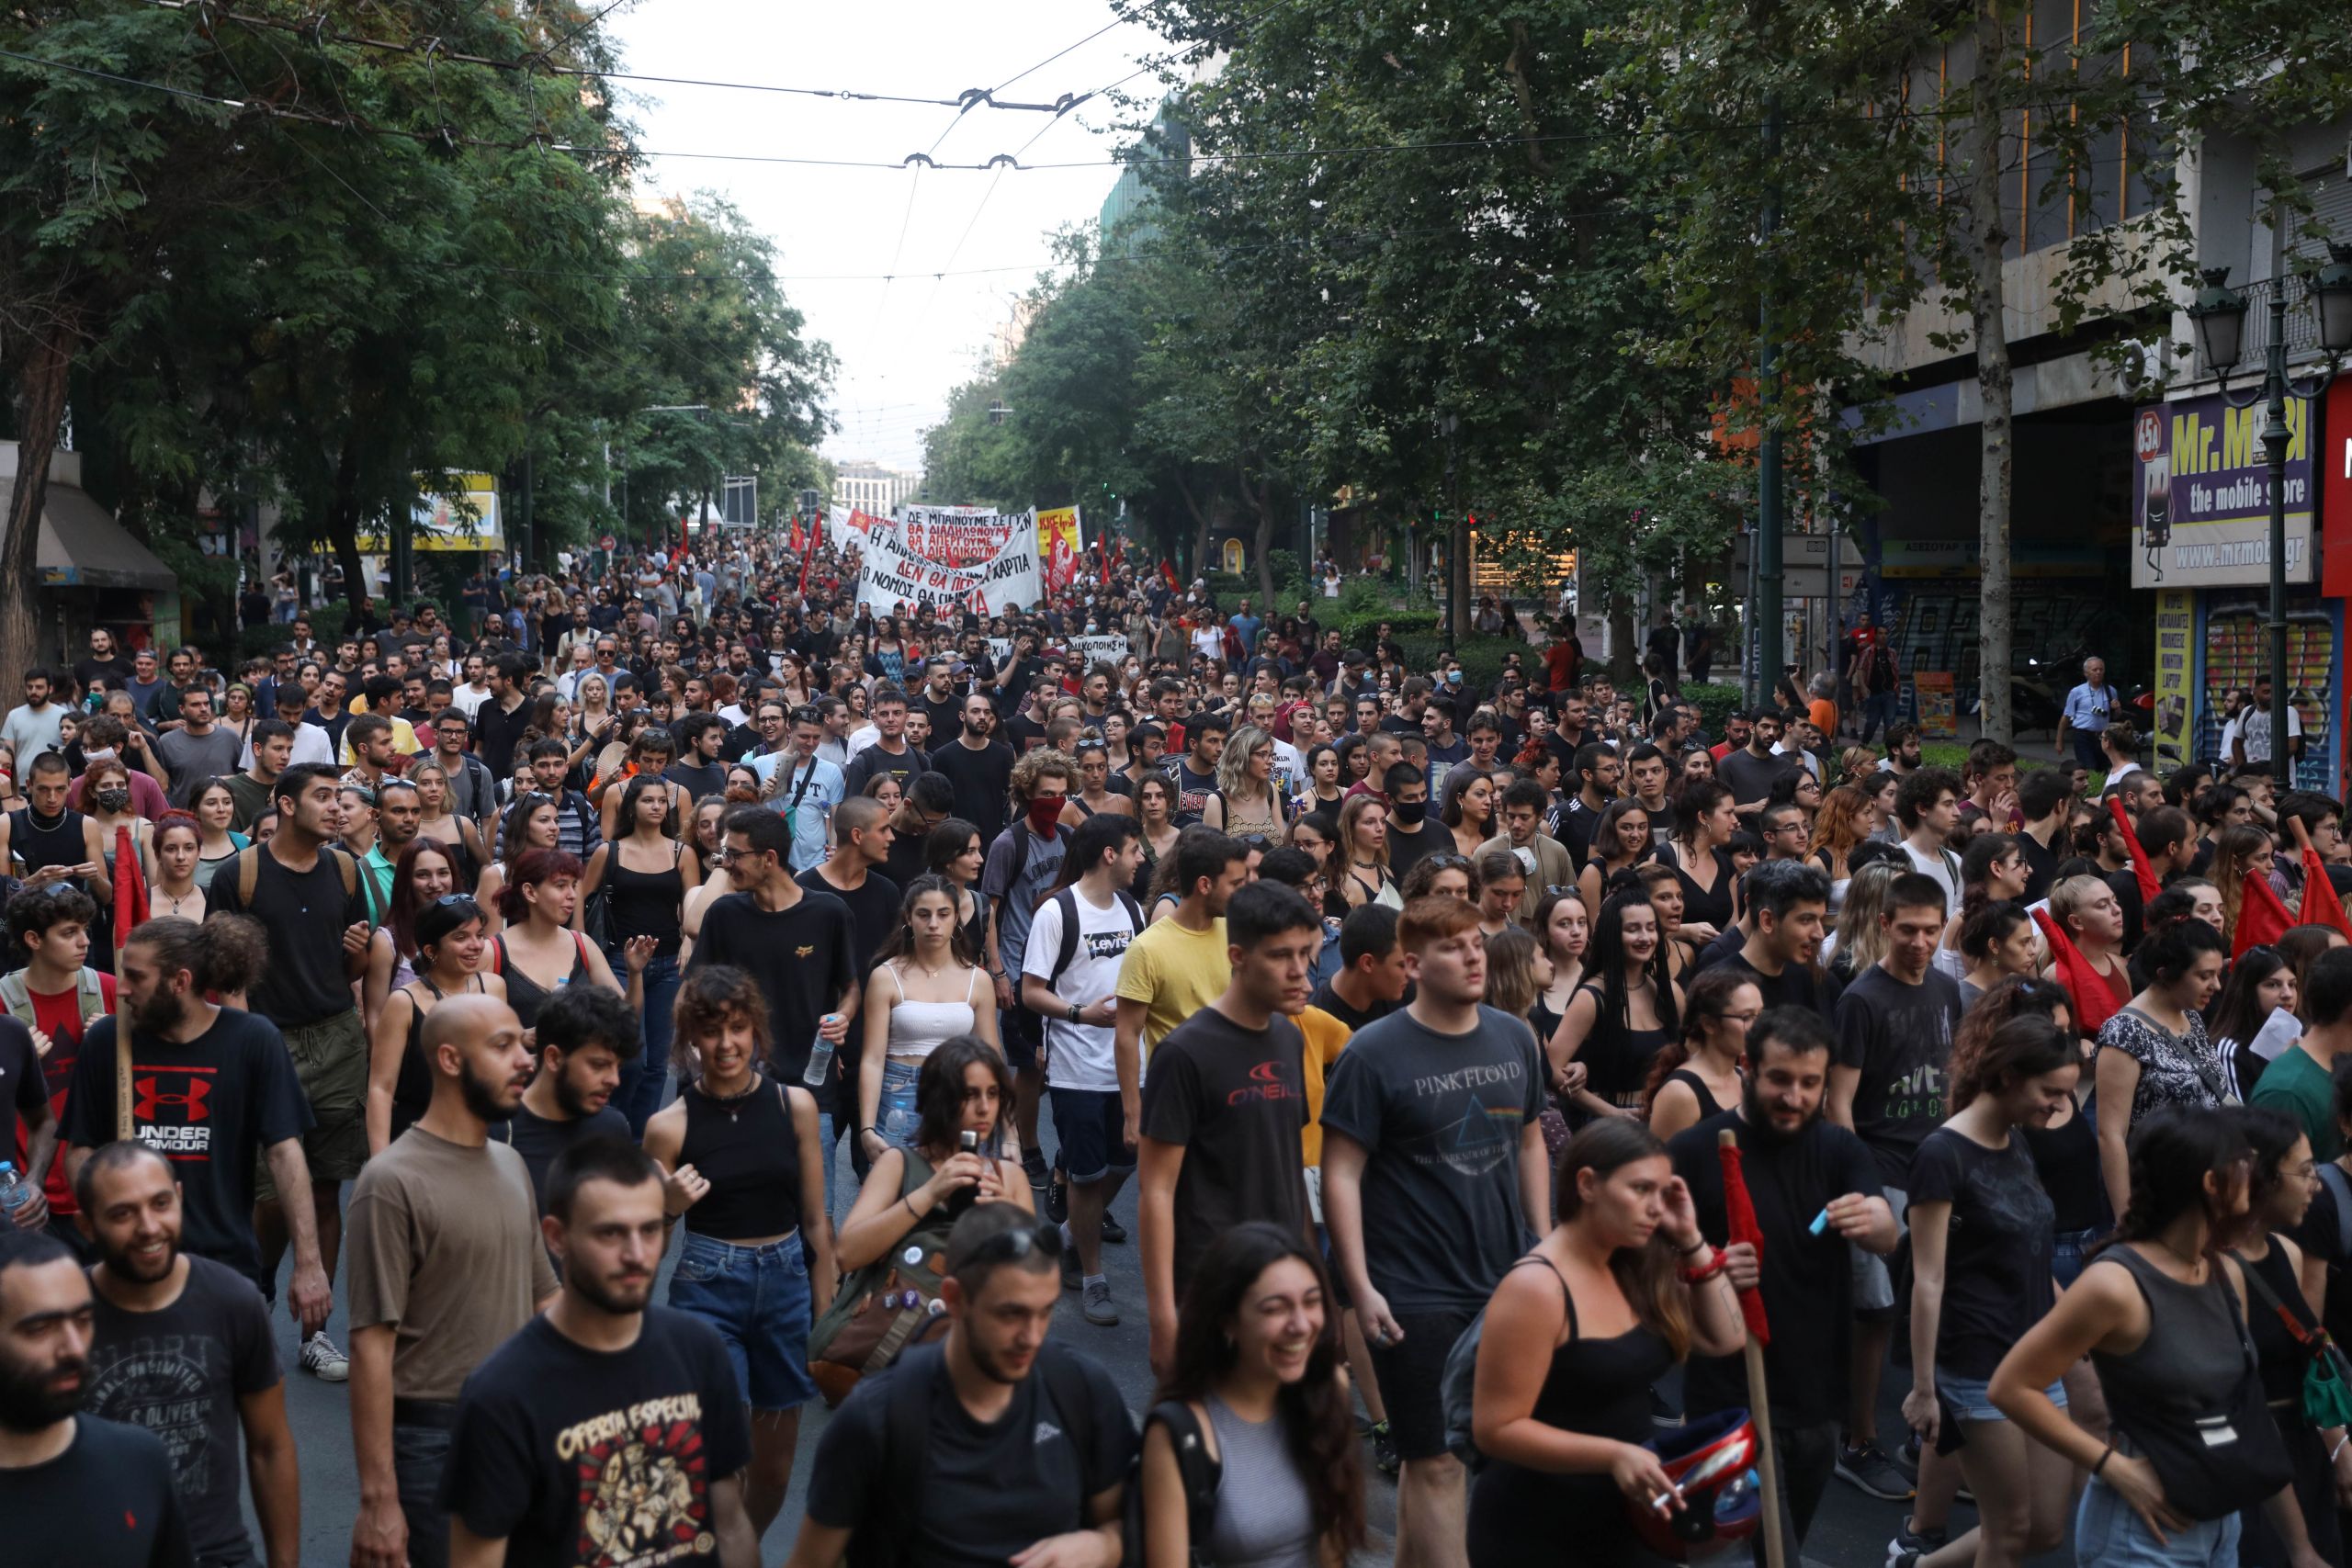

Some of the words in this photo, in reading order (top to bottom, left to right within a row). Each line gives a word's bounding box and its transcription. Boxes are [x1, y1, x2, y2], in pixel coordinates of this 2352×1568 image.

[2190, 484, 2212, 513] the
[2216, 477, 2262, 511] mobile
[2265, 477, 2304, 506] sore
[908, 512, 922, 524] ΔΕ
[929, 513, 989, 527] ΜΠΑΙΝΟΥΜΕ
[993, 515, 1007, 527] ΣΕ
[908, 524, 923, 535] ΘΑ
[908, 535, 922, 546] ΘΑ
[929, 535, 992, 547] ΑΠΕΡΓΟΥΜΕ
[2175, 529, 2304, 571] www.mrmobgr
[897, 559, 925, 582] ΔΕΝ
[928, 571, 948, 591] ΘΑ
[871, 570, 914, 599] ΝΟΜΟΣ
[918, 588, 935, 604] ΘΑ
[1414, 1071, 1464, 1097] PINK
[1464, 1061, 1521, 1089] FLOYD
[132, 1125, 211, 1140] UNDER
[145, 1140, 209, 1150] RMOUR
